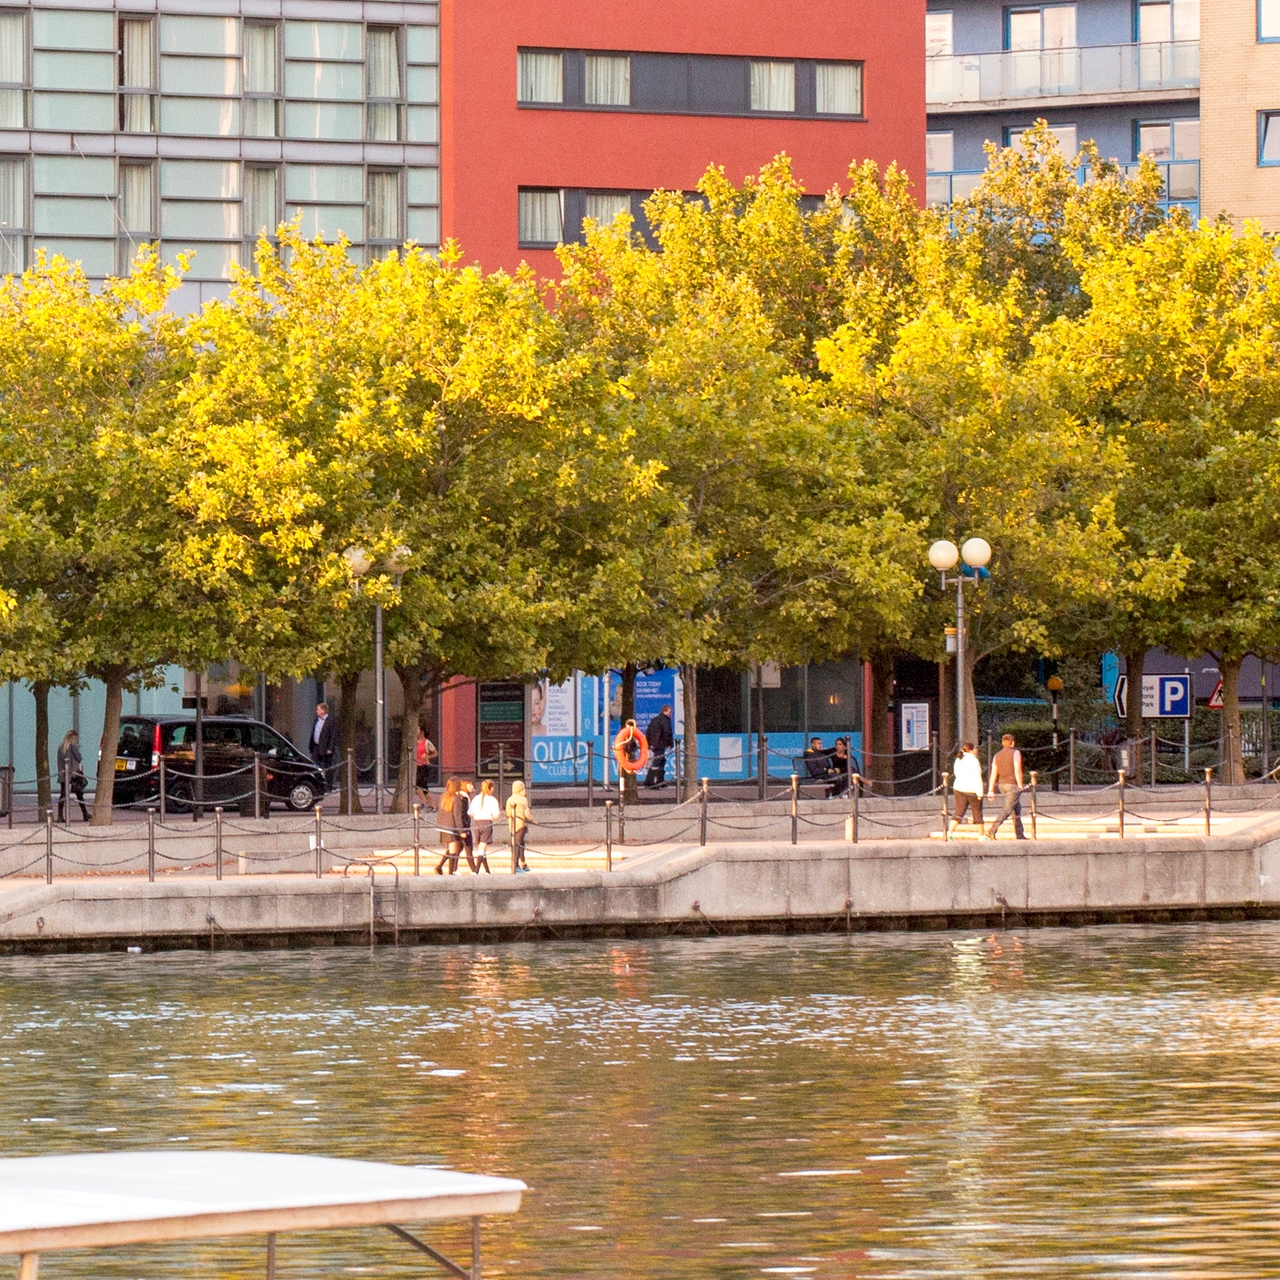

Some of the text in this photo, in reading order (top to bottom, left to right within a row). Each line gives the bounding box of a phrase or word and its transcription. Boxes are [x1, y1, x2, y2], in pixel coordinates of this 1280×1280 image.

[1165, 681, 1184, 712] P
[533, 741, 589, 770] QUAD
[548, 766, 567, 776] CLUB
